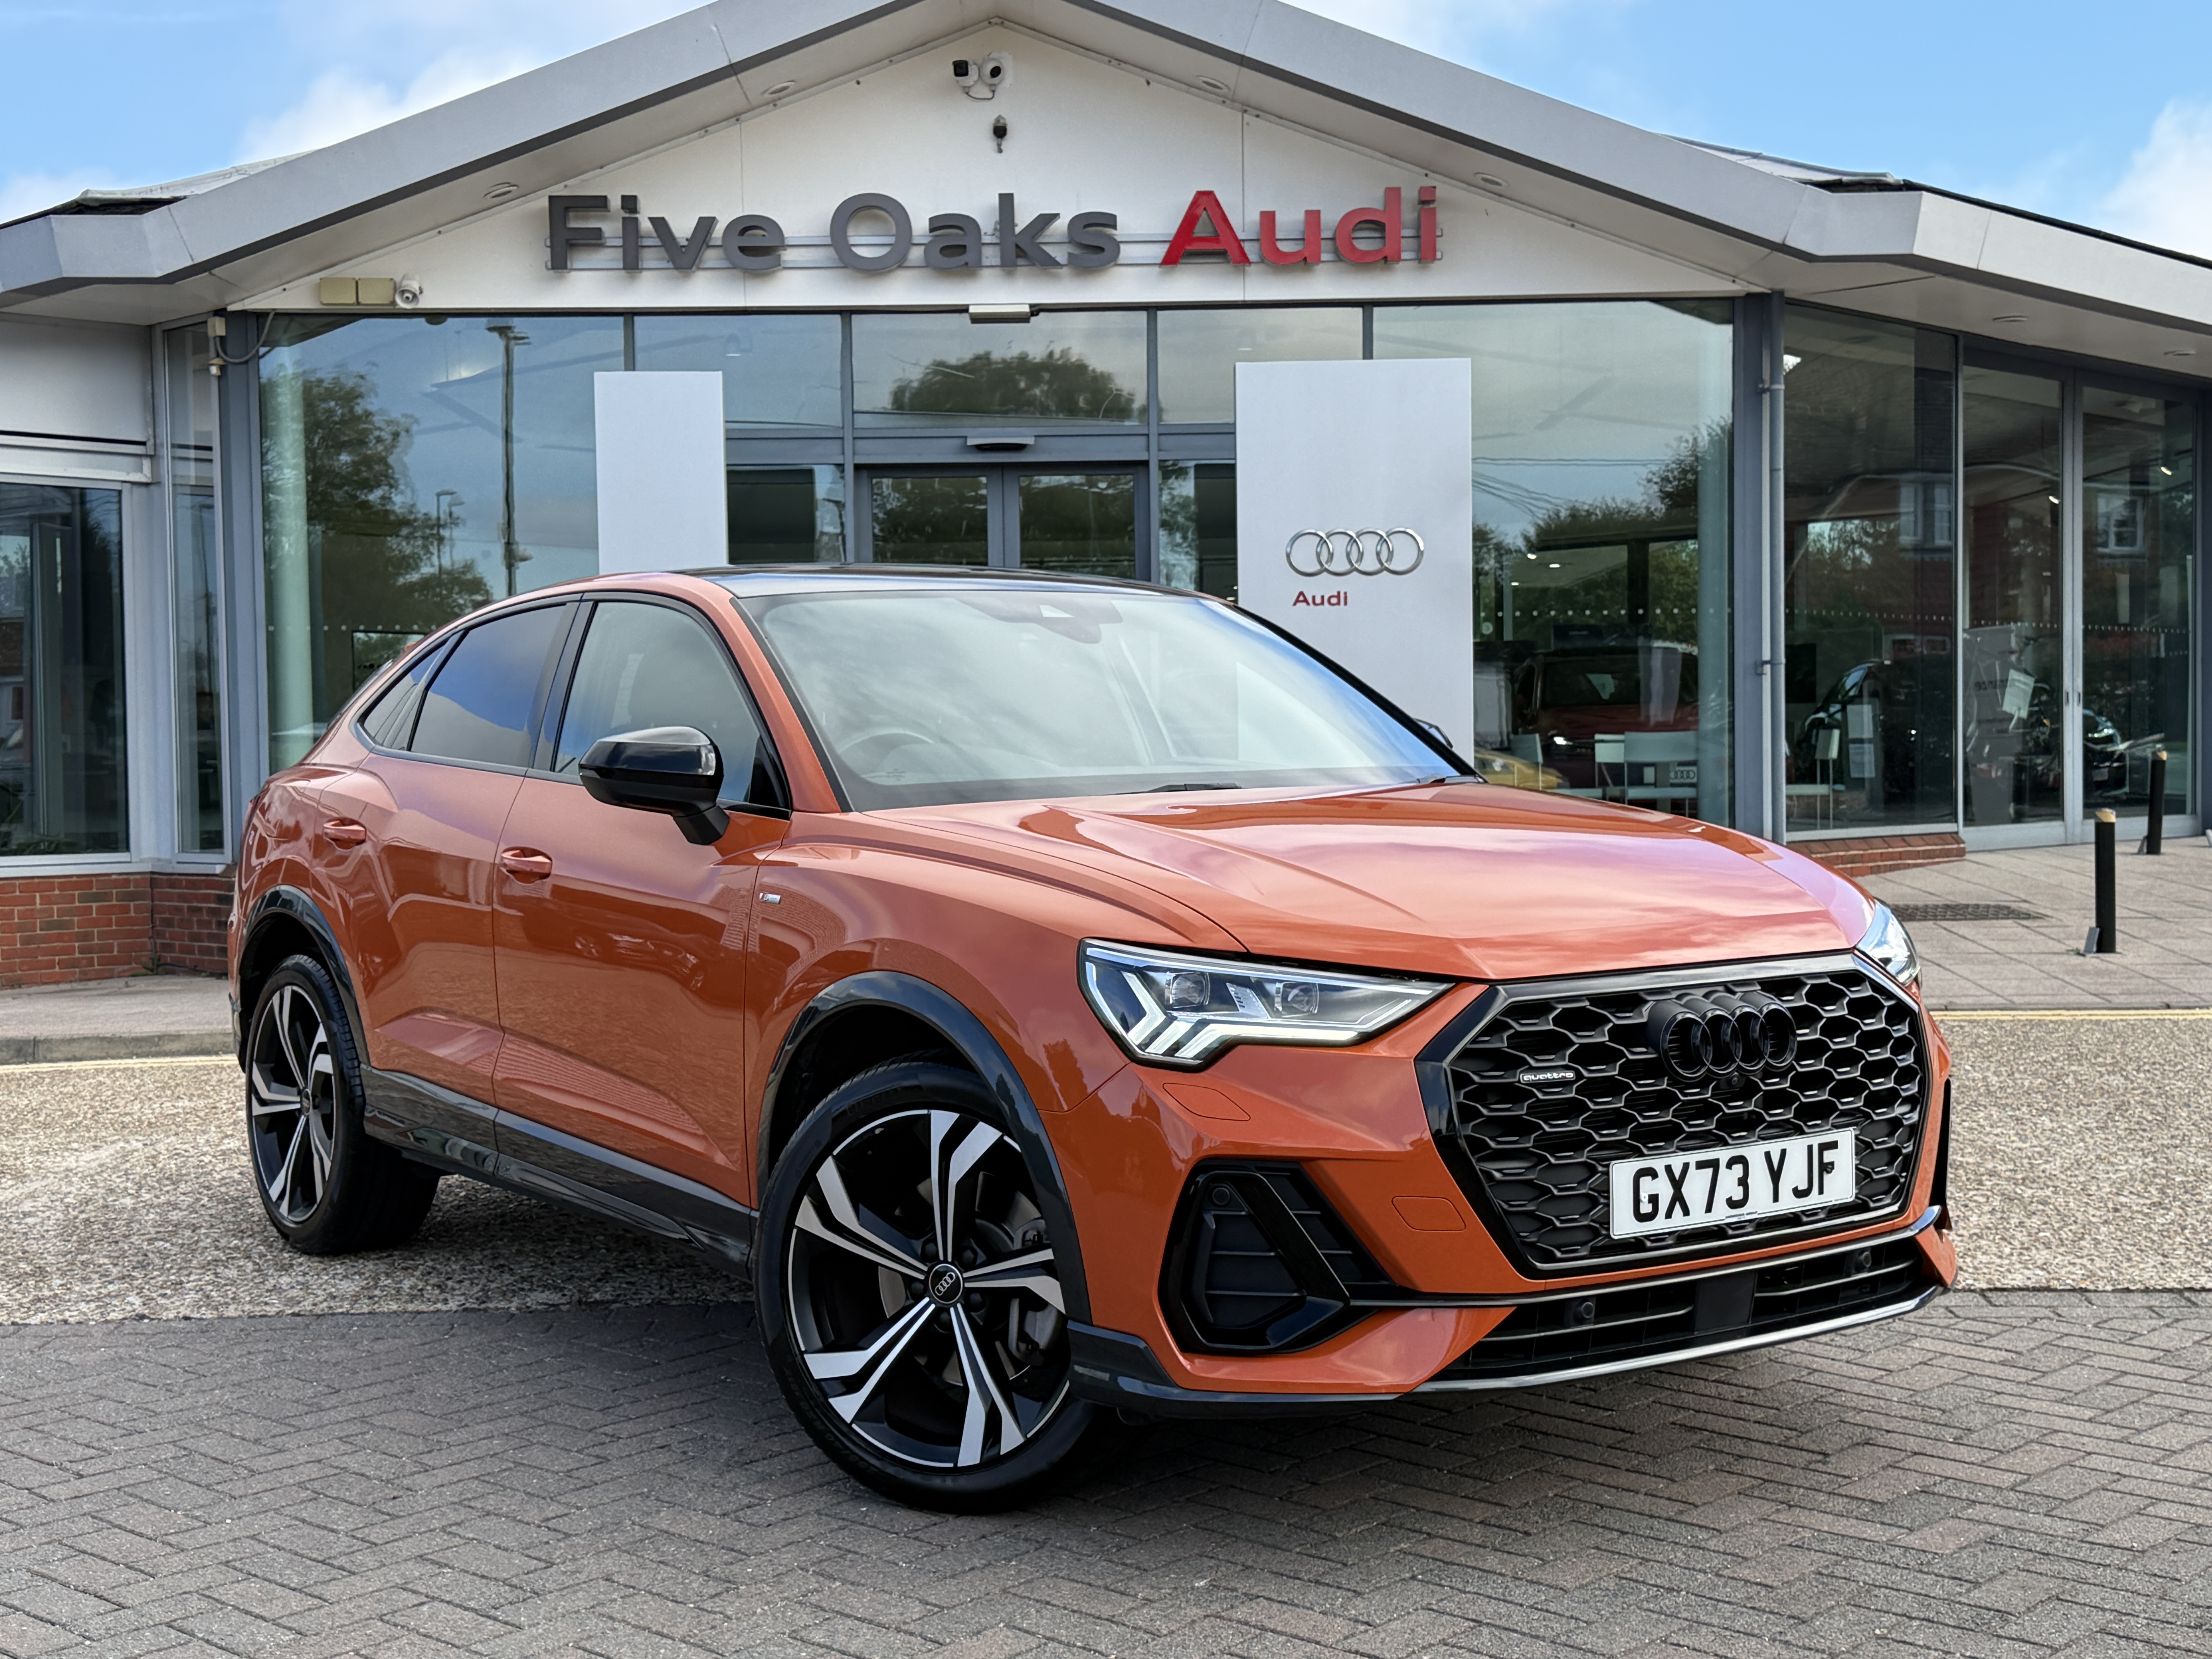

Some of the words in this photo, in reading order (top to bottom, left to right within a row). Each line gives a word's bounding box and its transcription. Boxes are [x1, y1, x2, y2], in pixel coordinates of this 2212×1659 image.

[548, 195, 786, 271] Five
[830, 192, 1121, 271] Oaks
[1159, 186, 1436, 266] Audi
[1292, 590, 1348, 606] Audi
[1523, 1072, 1574, 1082] quattro
[1632, 1154, 1750, 1223] GX73
[1764, 1140, 1839, 1204] YJF
